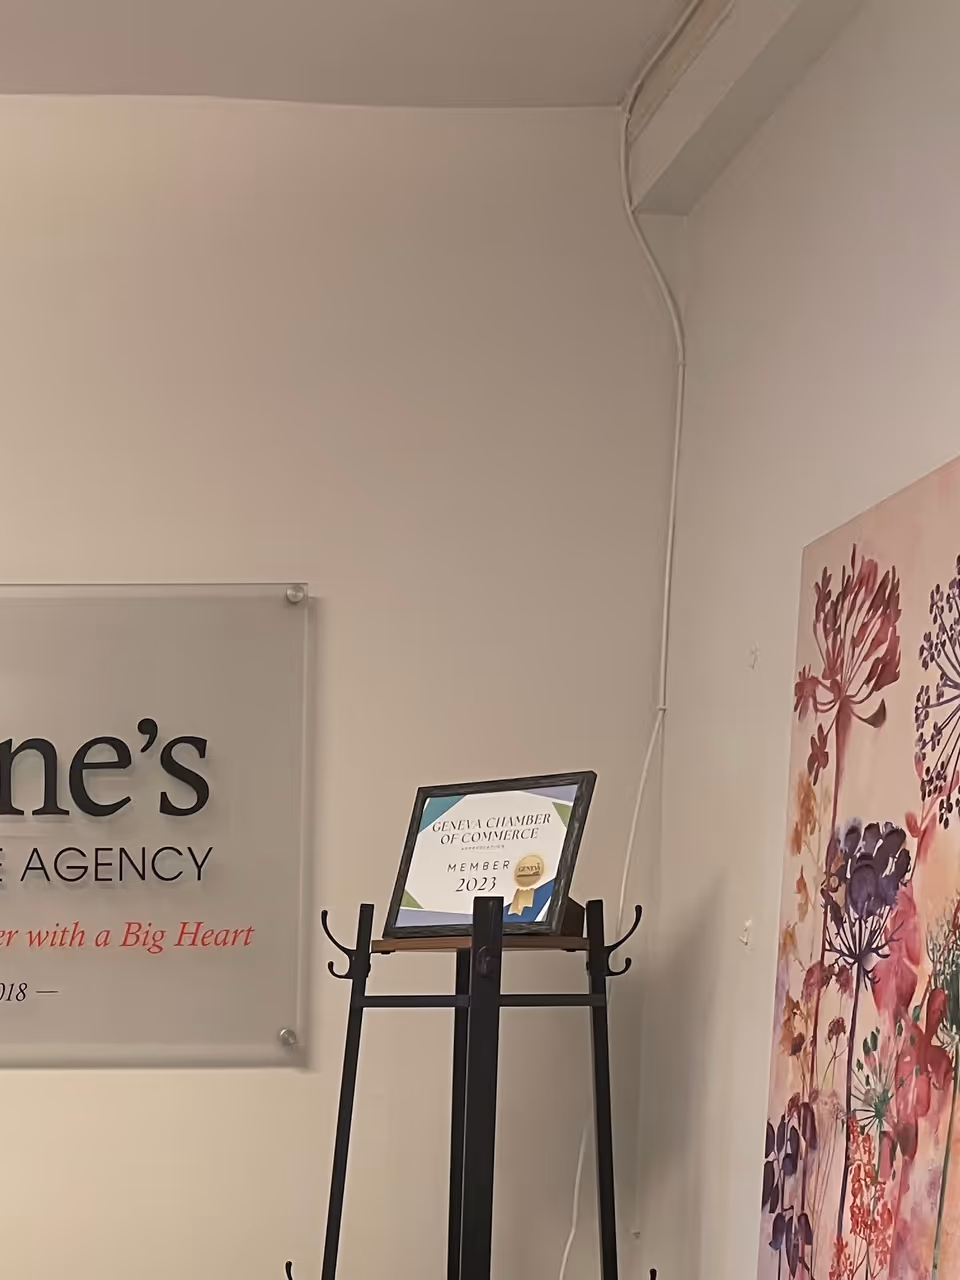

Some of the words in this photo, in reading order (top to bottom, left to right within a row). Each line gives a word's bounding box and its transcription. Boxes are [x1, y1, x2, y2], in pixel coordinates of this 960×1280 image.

[432, 819, 482, 833] GENEVA
[486, 813, 551, 828] CHAMBER
[440, 833, 461, 845] OF
[461, 828, 539, 843] COMMERCE
[21, 847, 214, 883] AGENCY
[447, 860, 510, 873] MEMBER
[455, 876, 497, 893] 2023
[28, 920, 85, 949] with
[94, 929, 111, 949] a
[121, 920, 166, 955] Big
[176, 920, 254, 949] Heart
